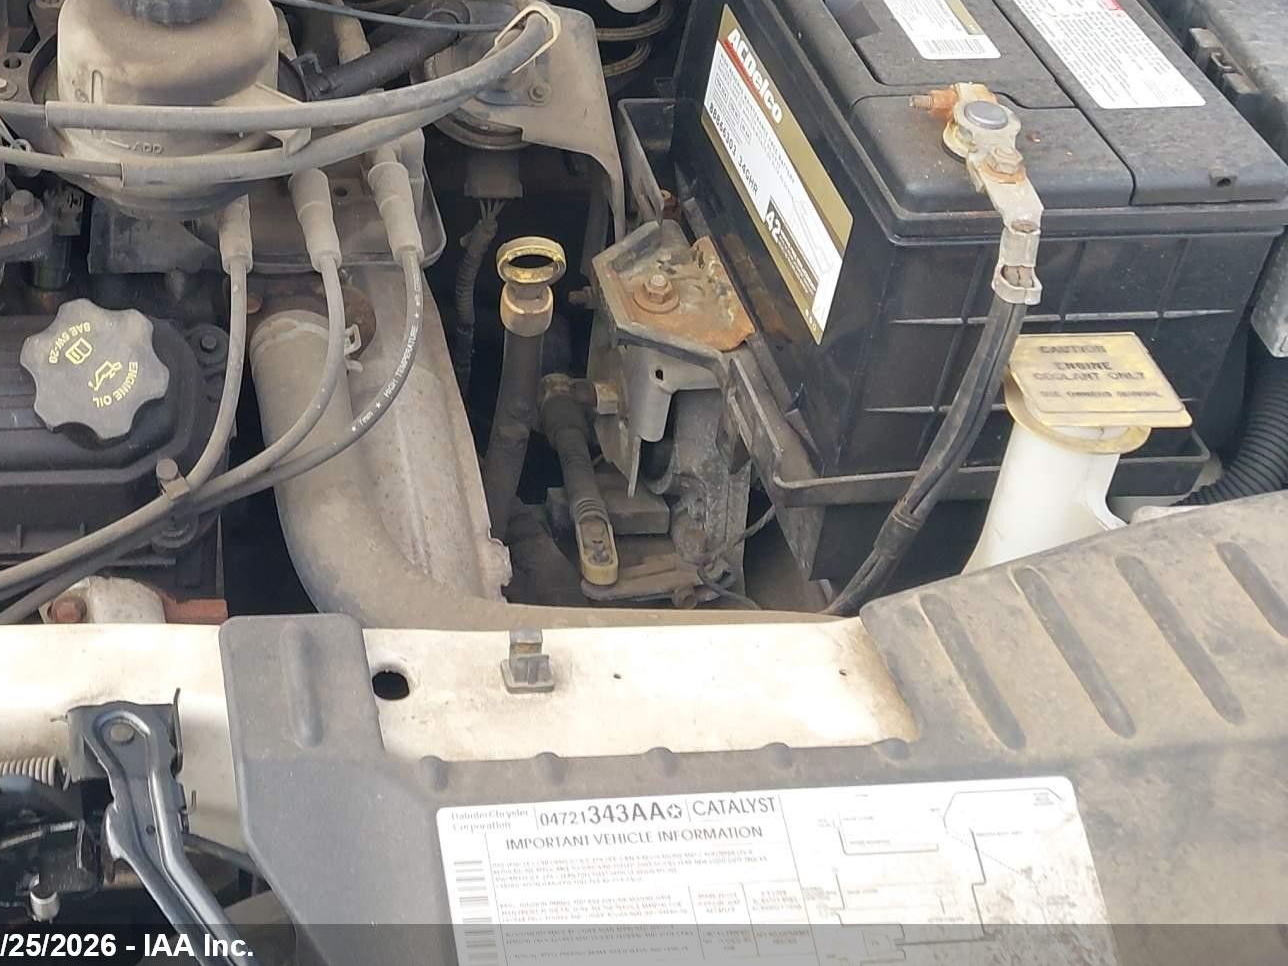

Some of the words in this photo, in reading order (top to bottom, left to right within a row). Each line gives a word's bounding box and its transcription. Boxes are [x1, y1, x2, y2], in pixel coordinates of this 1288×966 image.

[727, 28, 782, 124] ACDelco
[765, 211, 782, 243] 42
[48, 333, 70, 364] 5W-20
[383, 378, 397, 398] HIGH
[394, 325, 419, 380] TEMPERATURE
[1033, 372, 1100, 381] COOLANT
[1106, 372, 1146, 380] ONLY
[1055, 361, 1112, 370] ENGINE
[112, 361, 139, 401] ENGINE
[93, 397, 112, 408] OIL
[692, 796, 777, 817] CATALYST
[505, 829, 590, 851] IMPORTANT
[593, 828, 655, 846] VEHICLE
[657, 825, 763, 842] INFORMATION
